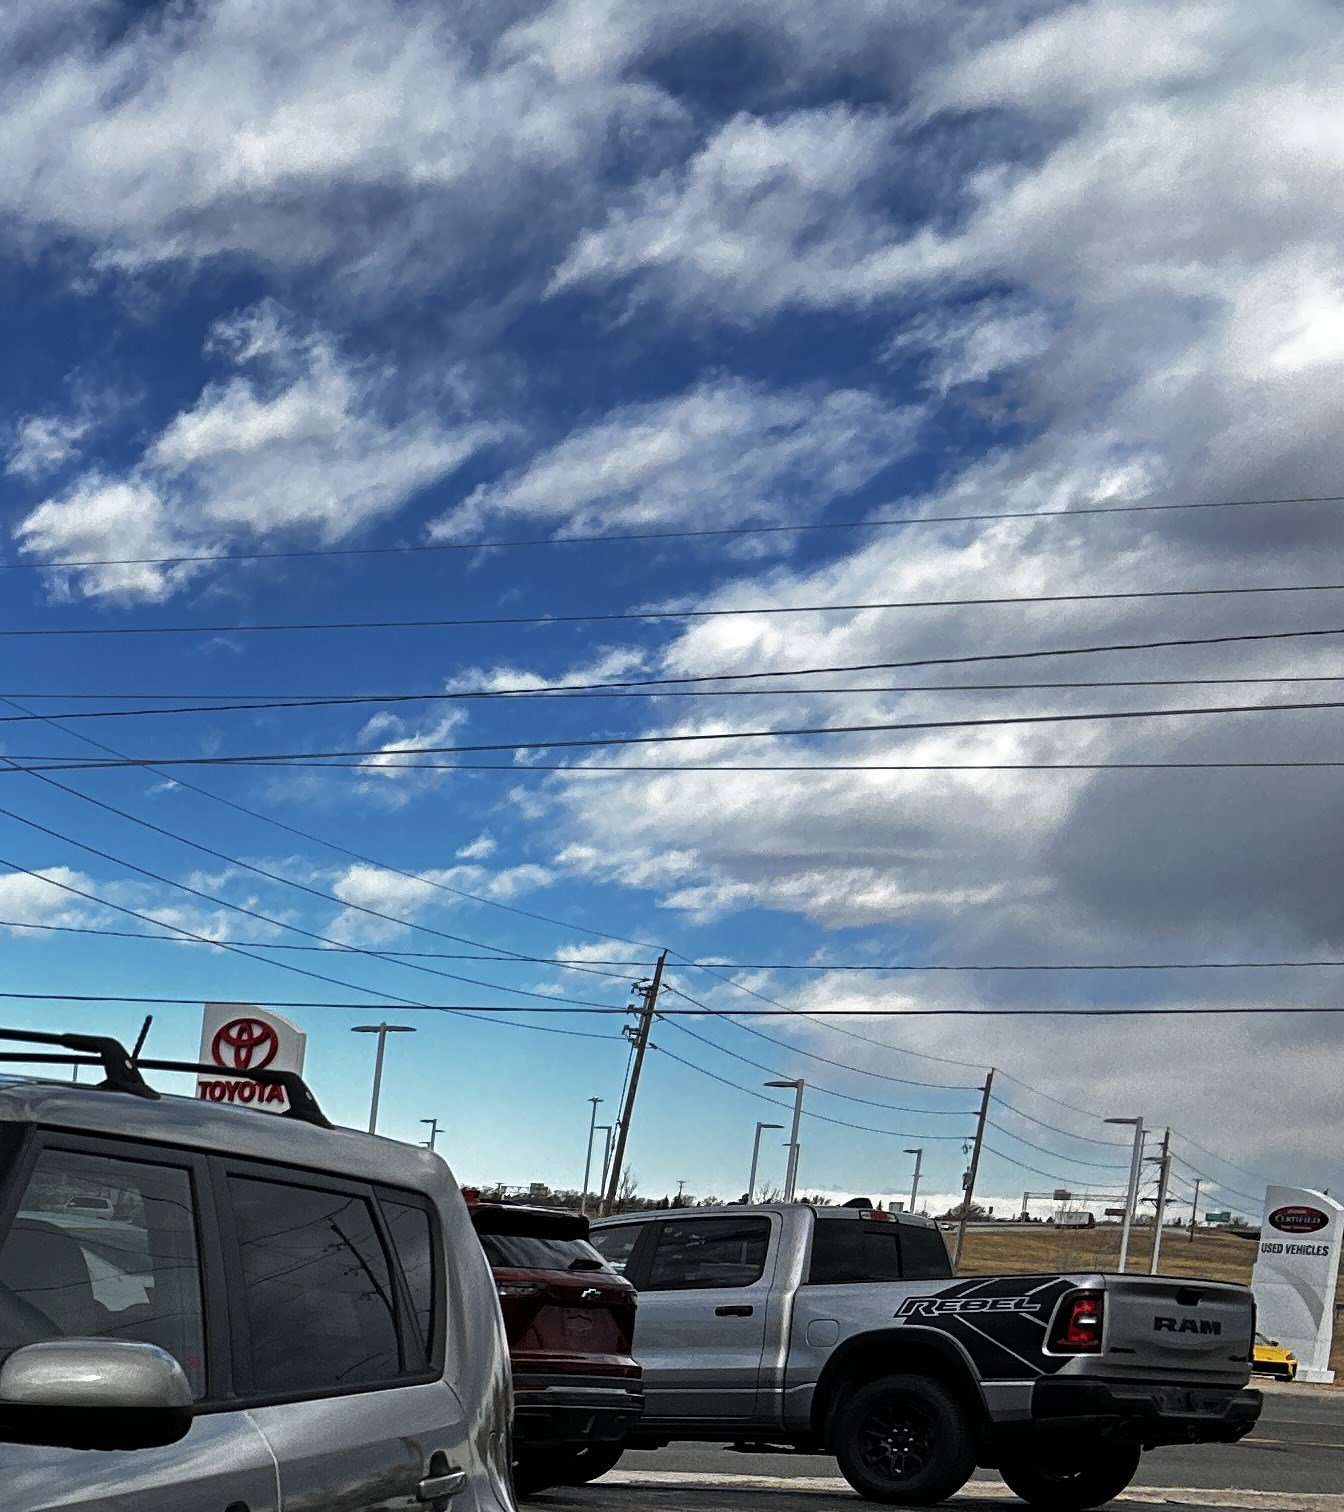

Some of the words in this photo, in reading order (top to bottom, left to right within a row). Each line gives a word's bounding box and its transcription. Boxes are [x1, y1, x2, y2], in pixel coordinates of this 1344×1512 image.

[198, 1080, 285, 1103] TOYOTA
[1261, 1243, 1284, 1254] USED
[1285, 1243, 1330, 1257] VEHICLES
[897, 1297, 1042, 1318] REBEL
[1153, 1316, 1222, 1336] RAM
